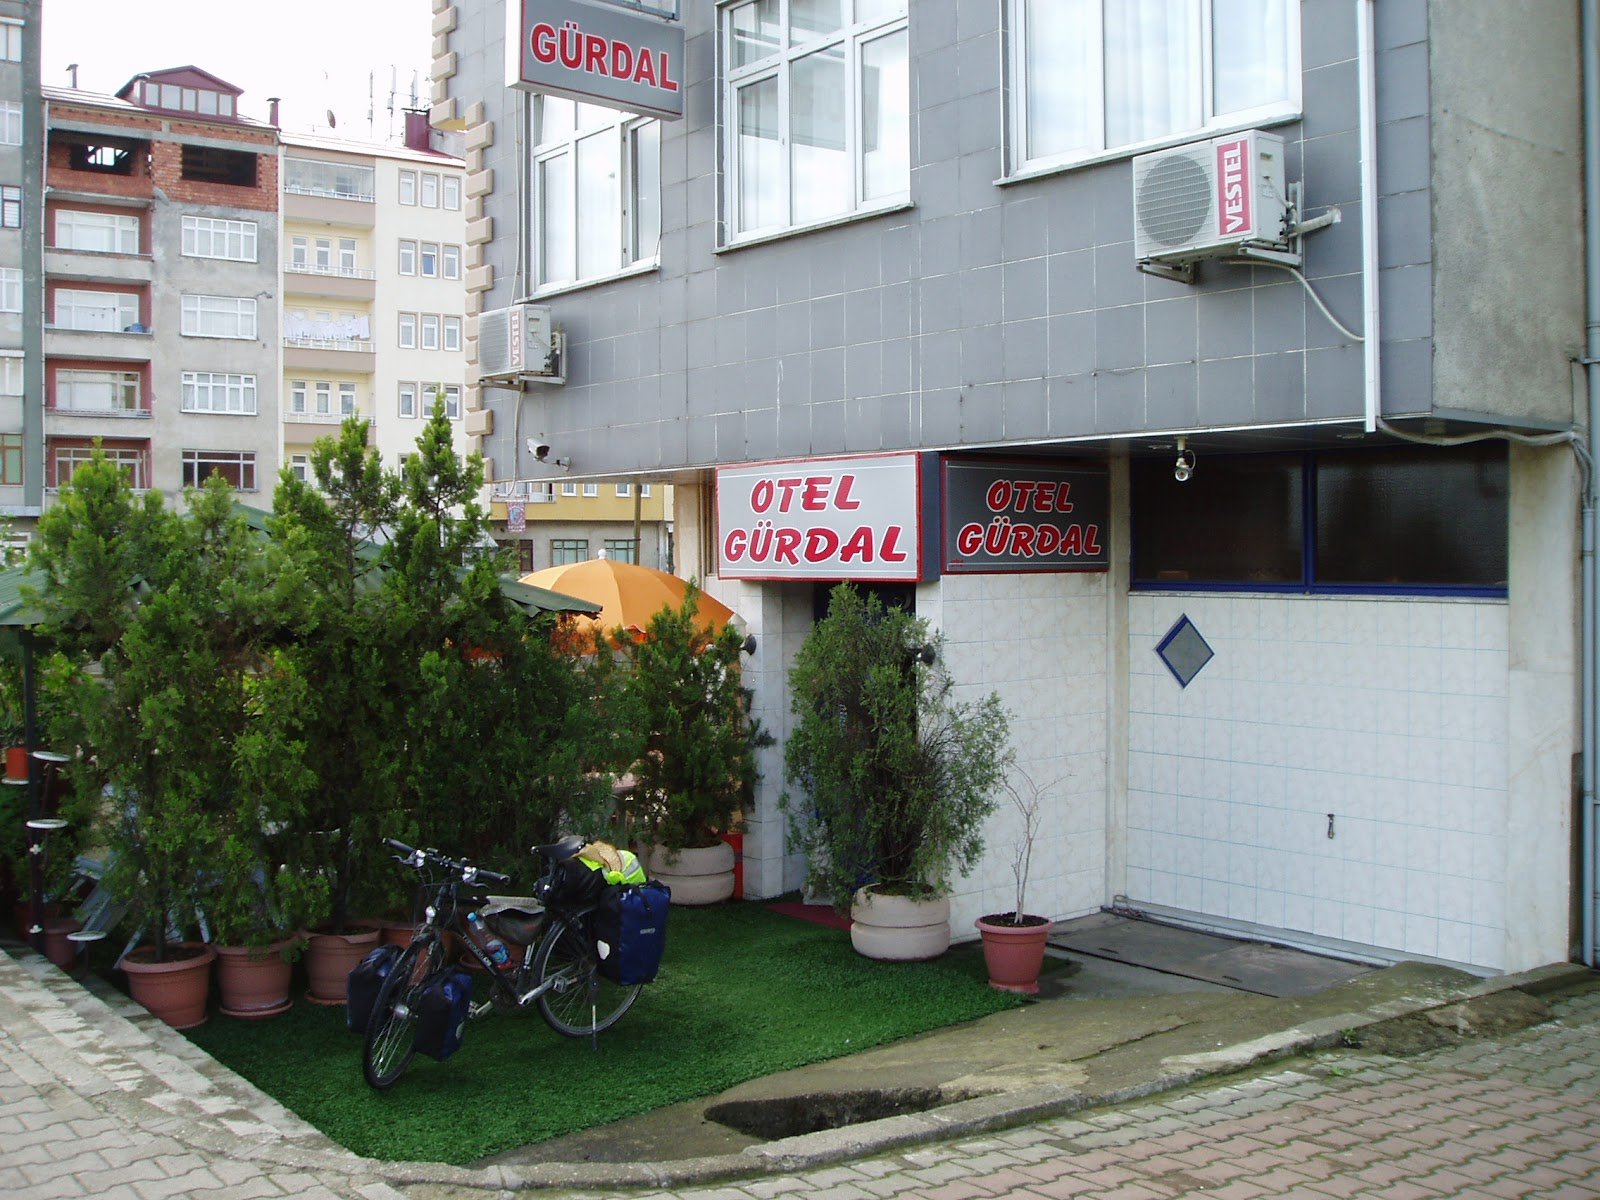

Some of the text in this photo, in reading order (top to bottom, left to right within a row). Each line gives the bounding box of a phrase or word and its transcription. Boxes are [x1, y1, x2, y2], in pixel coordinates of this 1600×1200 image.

[530, 20, 679, 93] GÜRDAL
[1223, 141, 1244, 233] VESTEL
[511, 310, 521, 366] VESTEL
[750, 474, 861, 515] OTEL
[986, 479, 1074, 514] OTEL
[724, 520, 909, 566] GÜRDAL
[956, 516, 1101, 558] GÜRDAL
